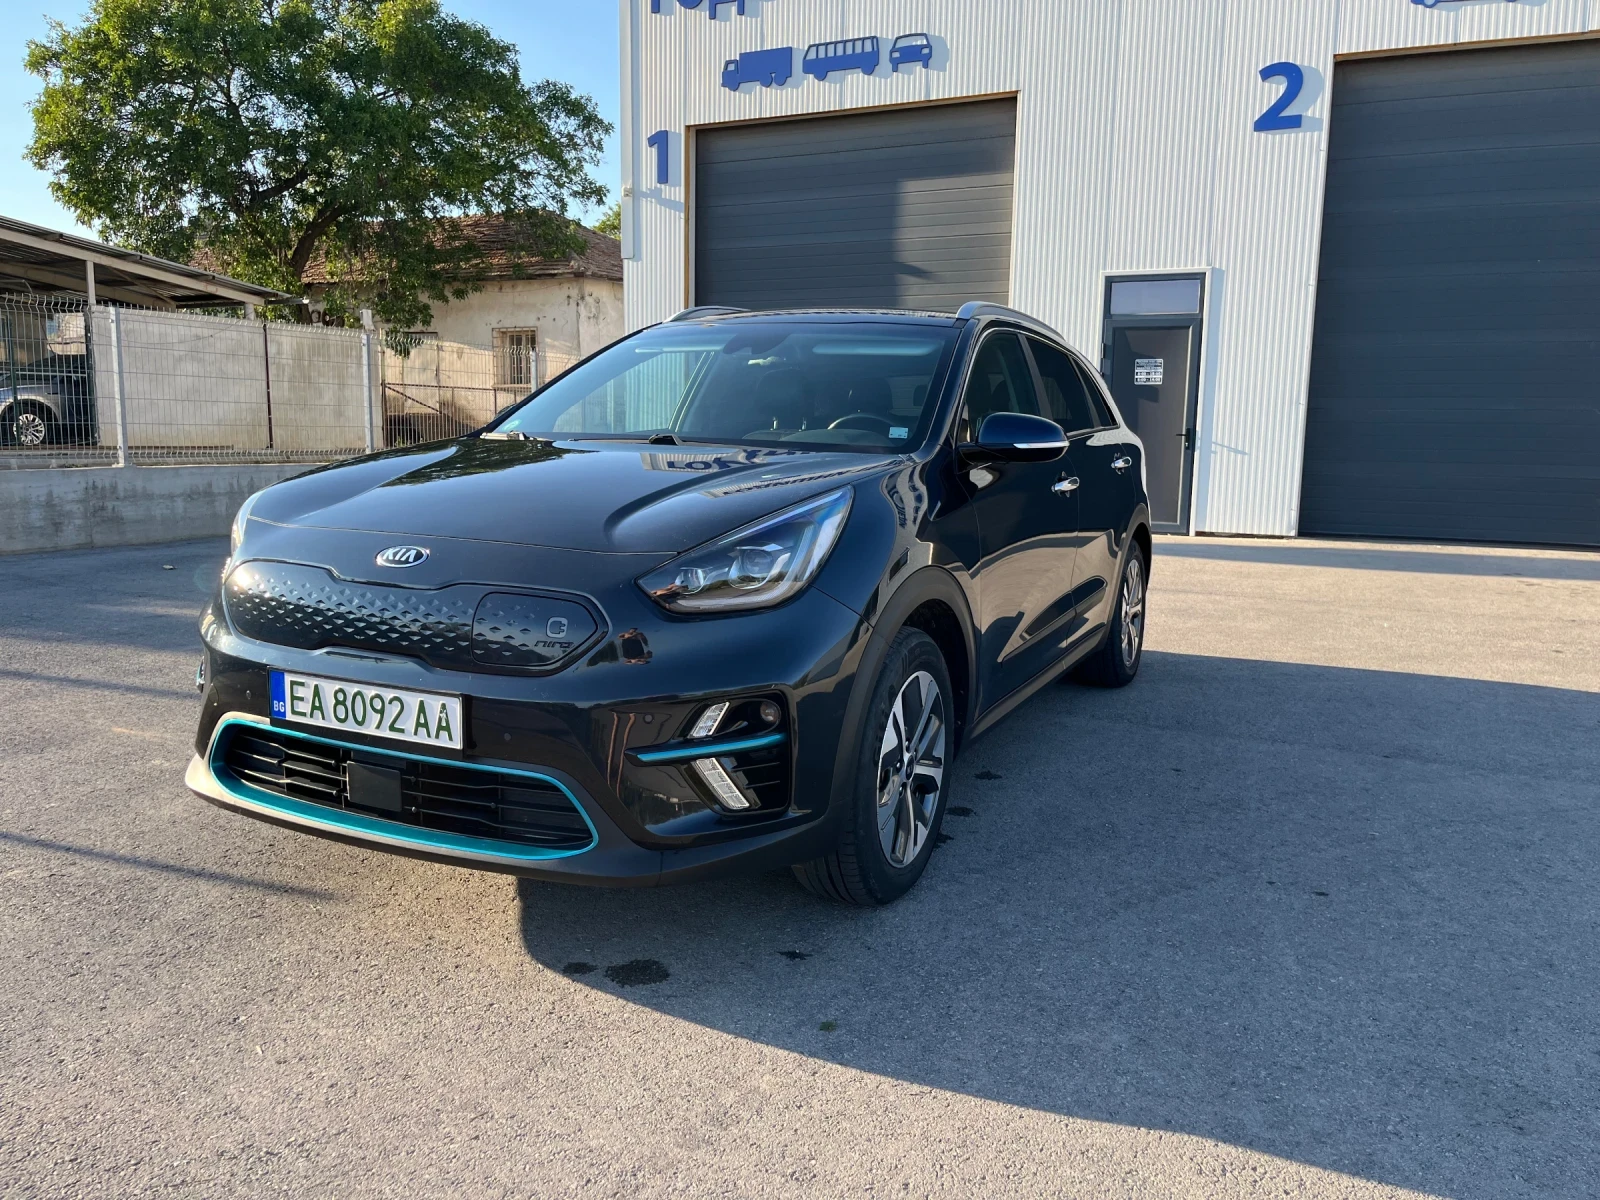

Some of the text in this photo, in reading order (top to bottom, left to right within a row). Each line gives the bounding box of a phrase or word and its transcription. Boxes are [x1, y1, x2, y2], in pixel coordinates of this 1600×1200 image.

[1253, 61, 1304, 132] 2
[647, 129, 668, 184] 1
[382, 547, 417, 563] KIA
[273, 700, 285, 712] BG
